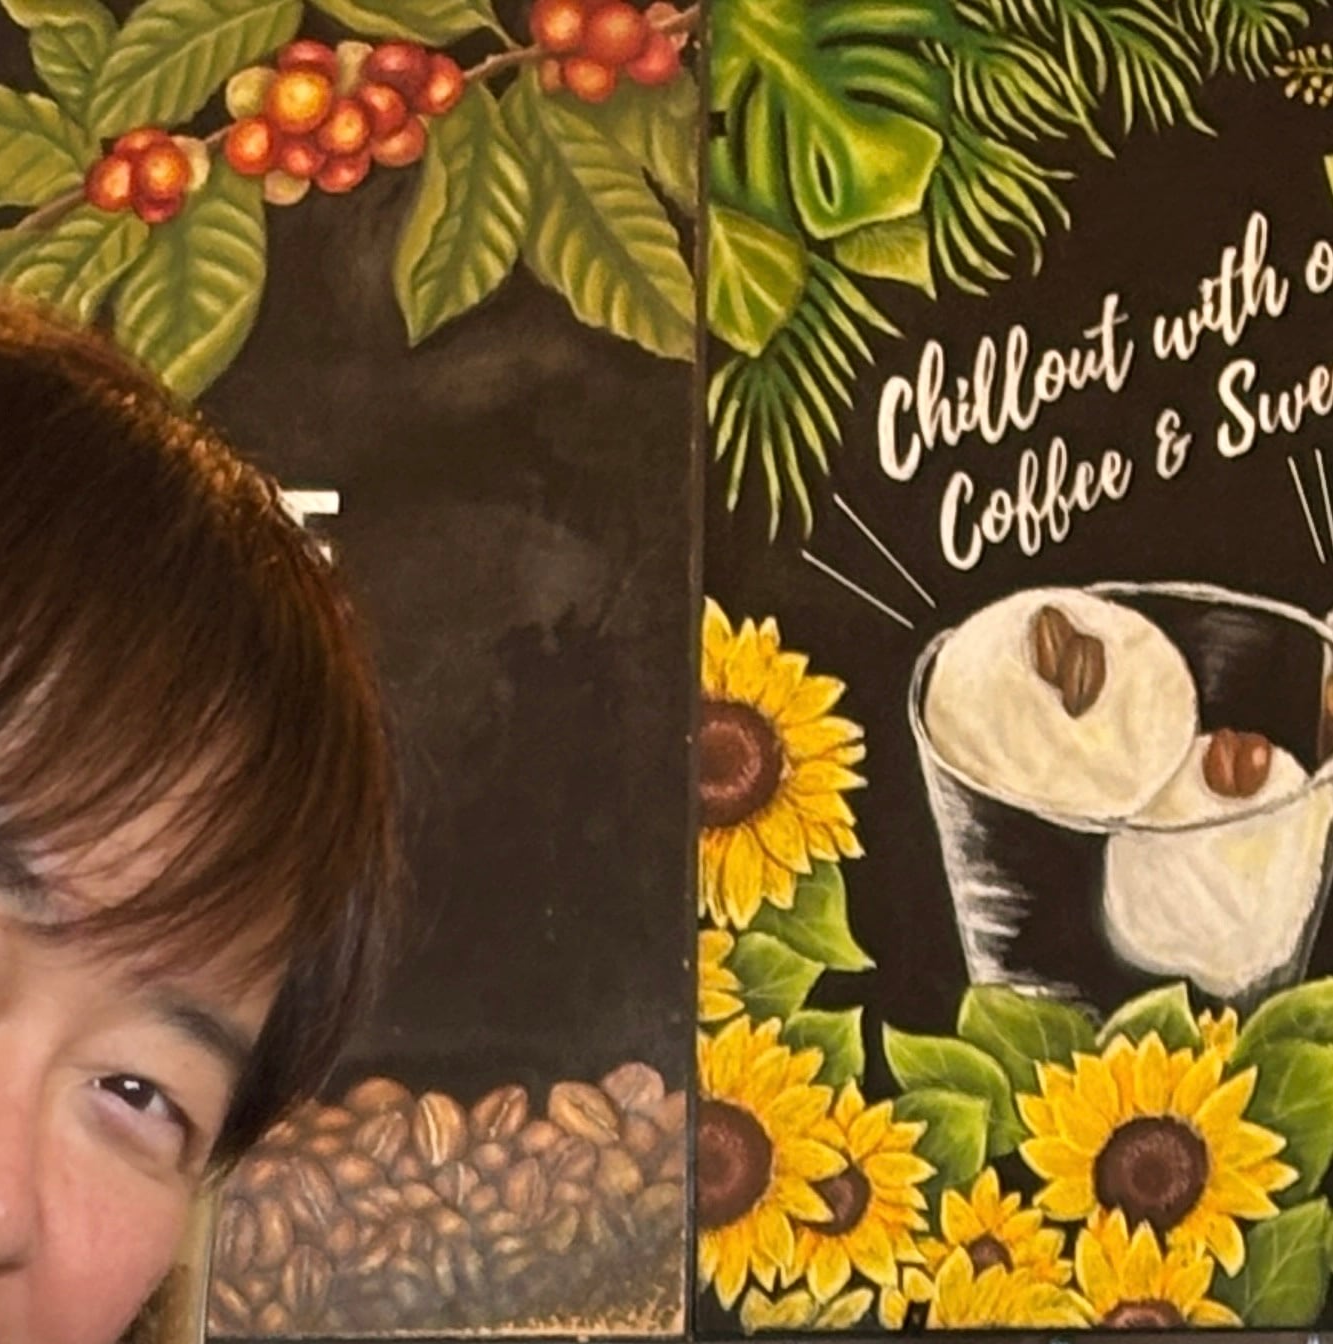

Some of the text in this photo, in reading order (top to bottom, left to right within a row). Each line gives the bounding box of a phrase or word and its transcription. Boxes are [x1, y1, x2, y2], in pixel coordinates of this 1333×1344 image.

[878, 293, 1135, 481] Chillout
[1153, 210, 1290, 361] with
[941, 437, 1133, 571] Coffee
[1156, 408, 1191, 480] &
